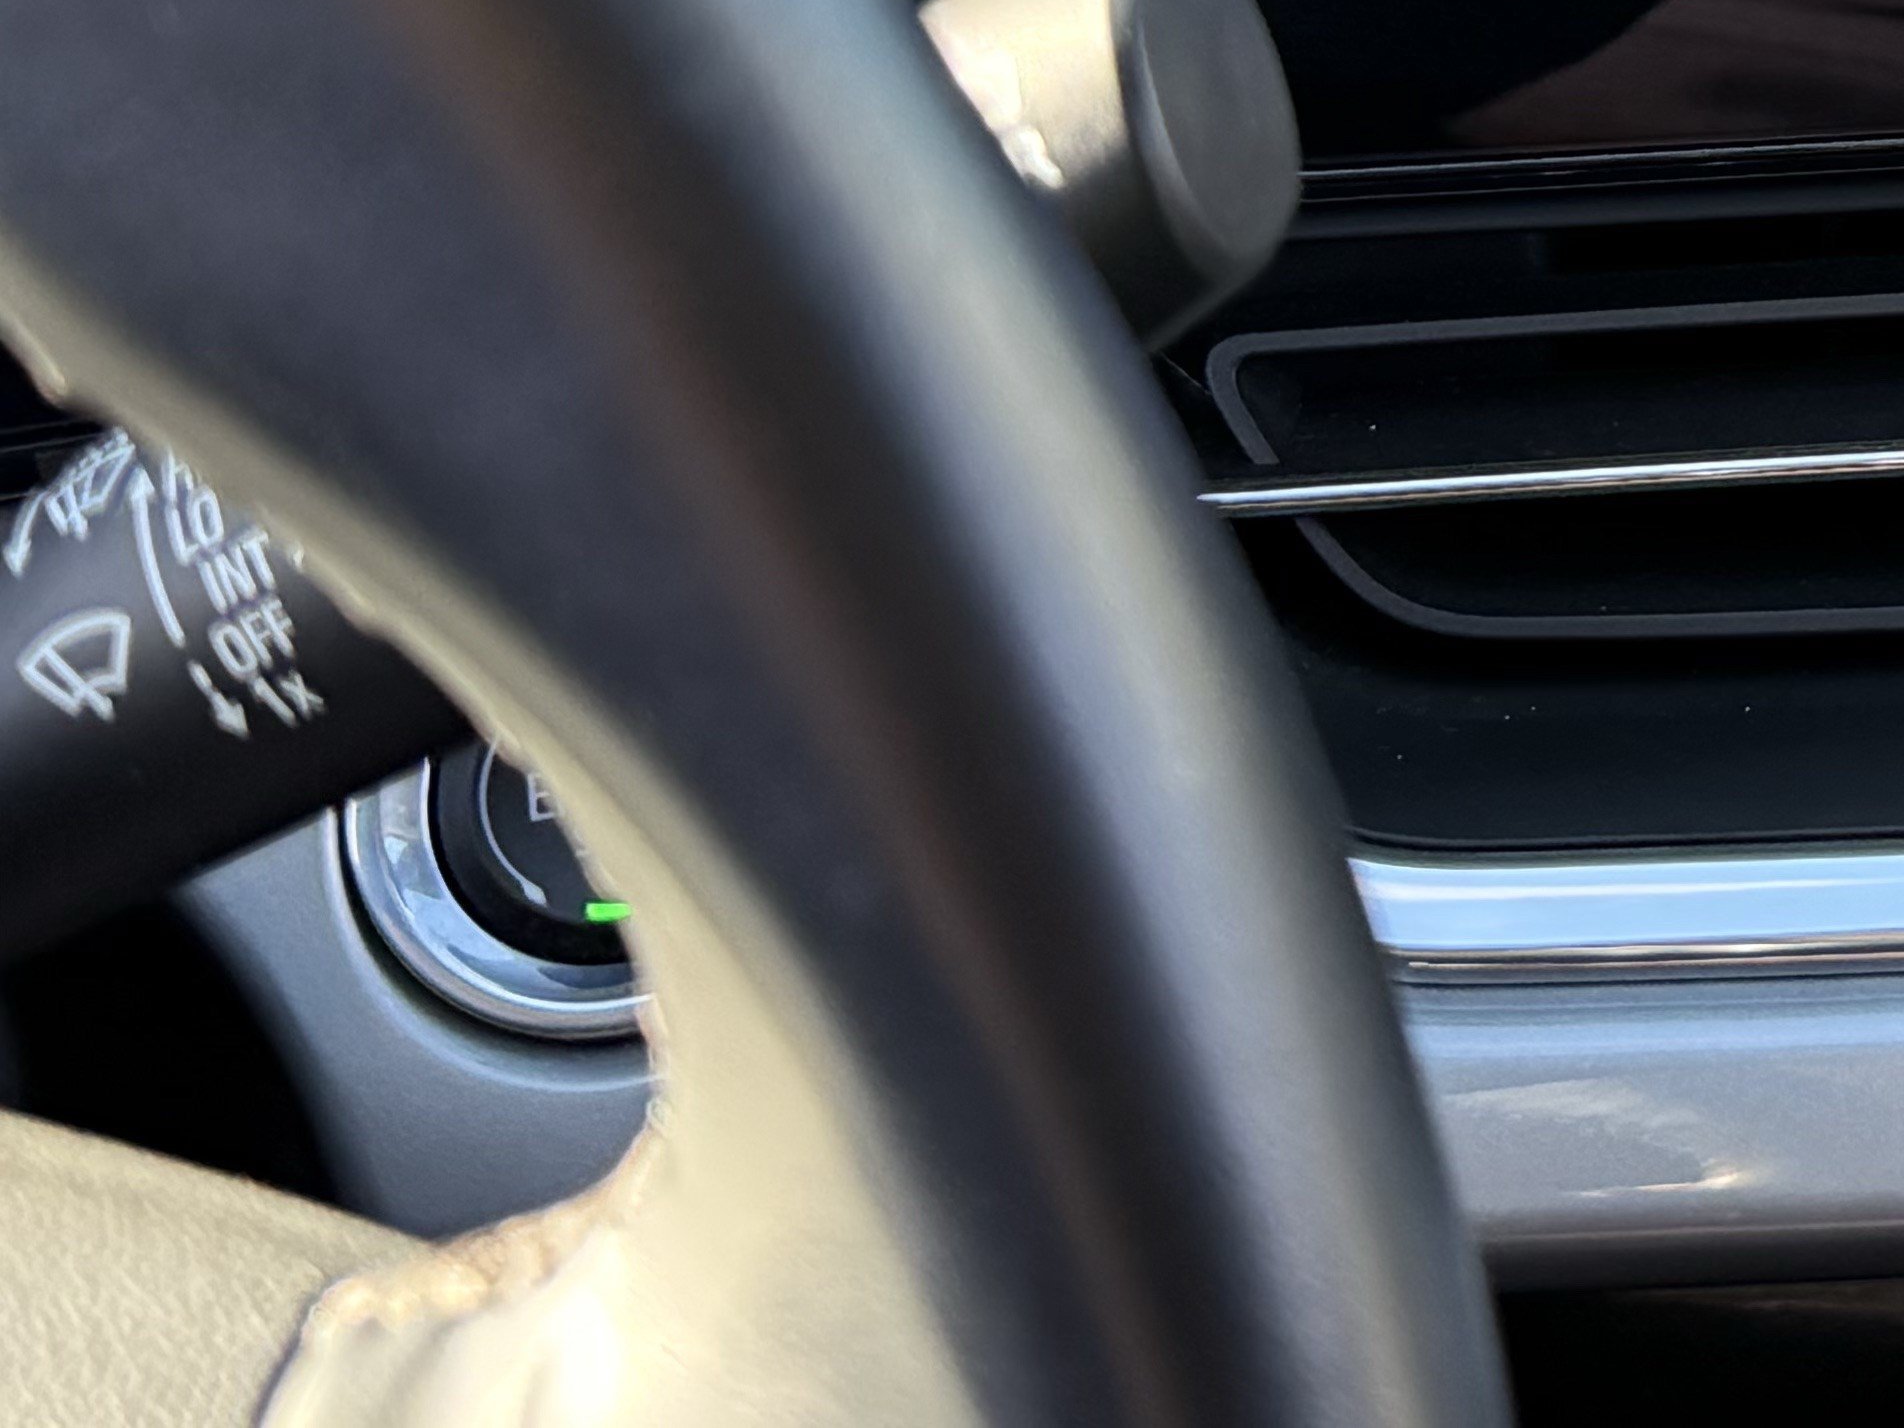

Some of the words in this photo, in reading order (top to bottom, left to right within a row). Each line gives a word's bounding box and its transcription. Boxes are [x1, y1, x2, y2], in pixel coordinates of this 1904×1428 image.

[163, 486, 225, 566] LO
[198, 524, 276, 615] INT
[207, 598, 297, 682] OFF
